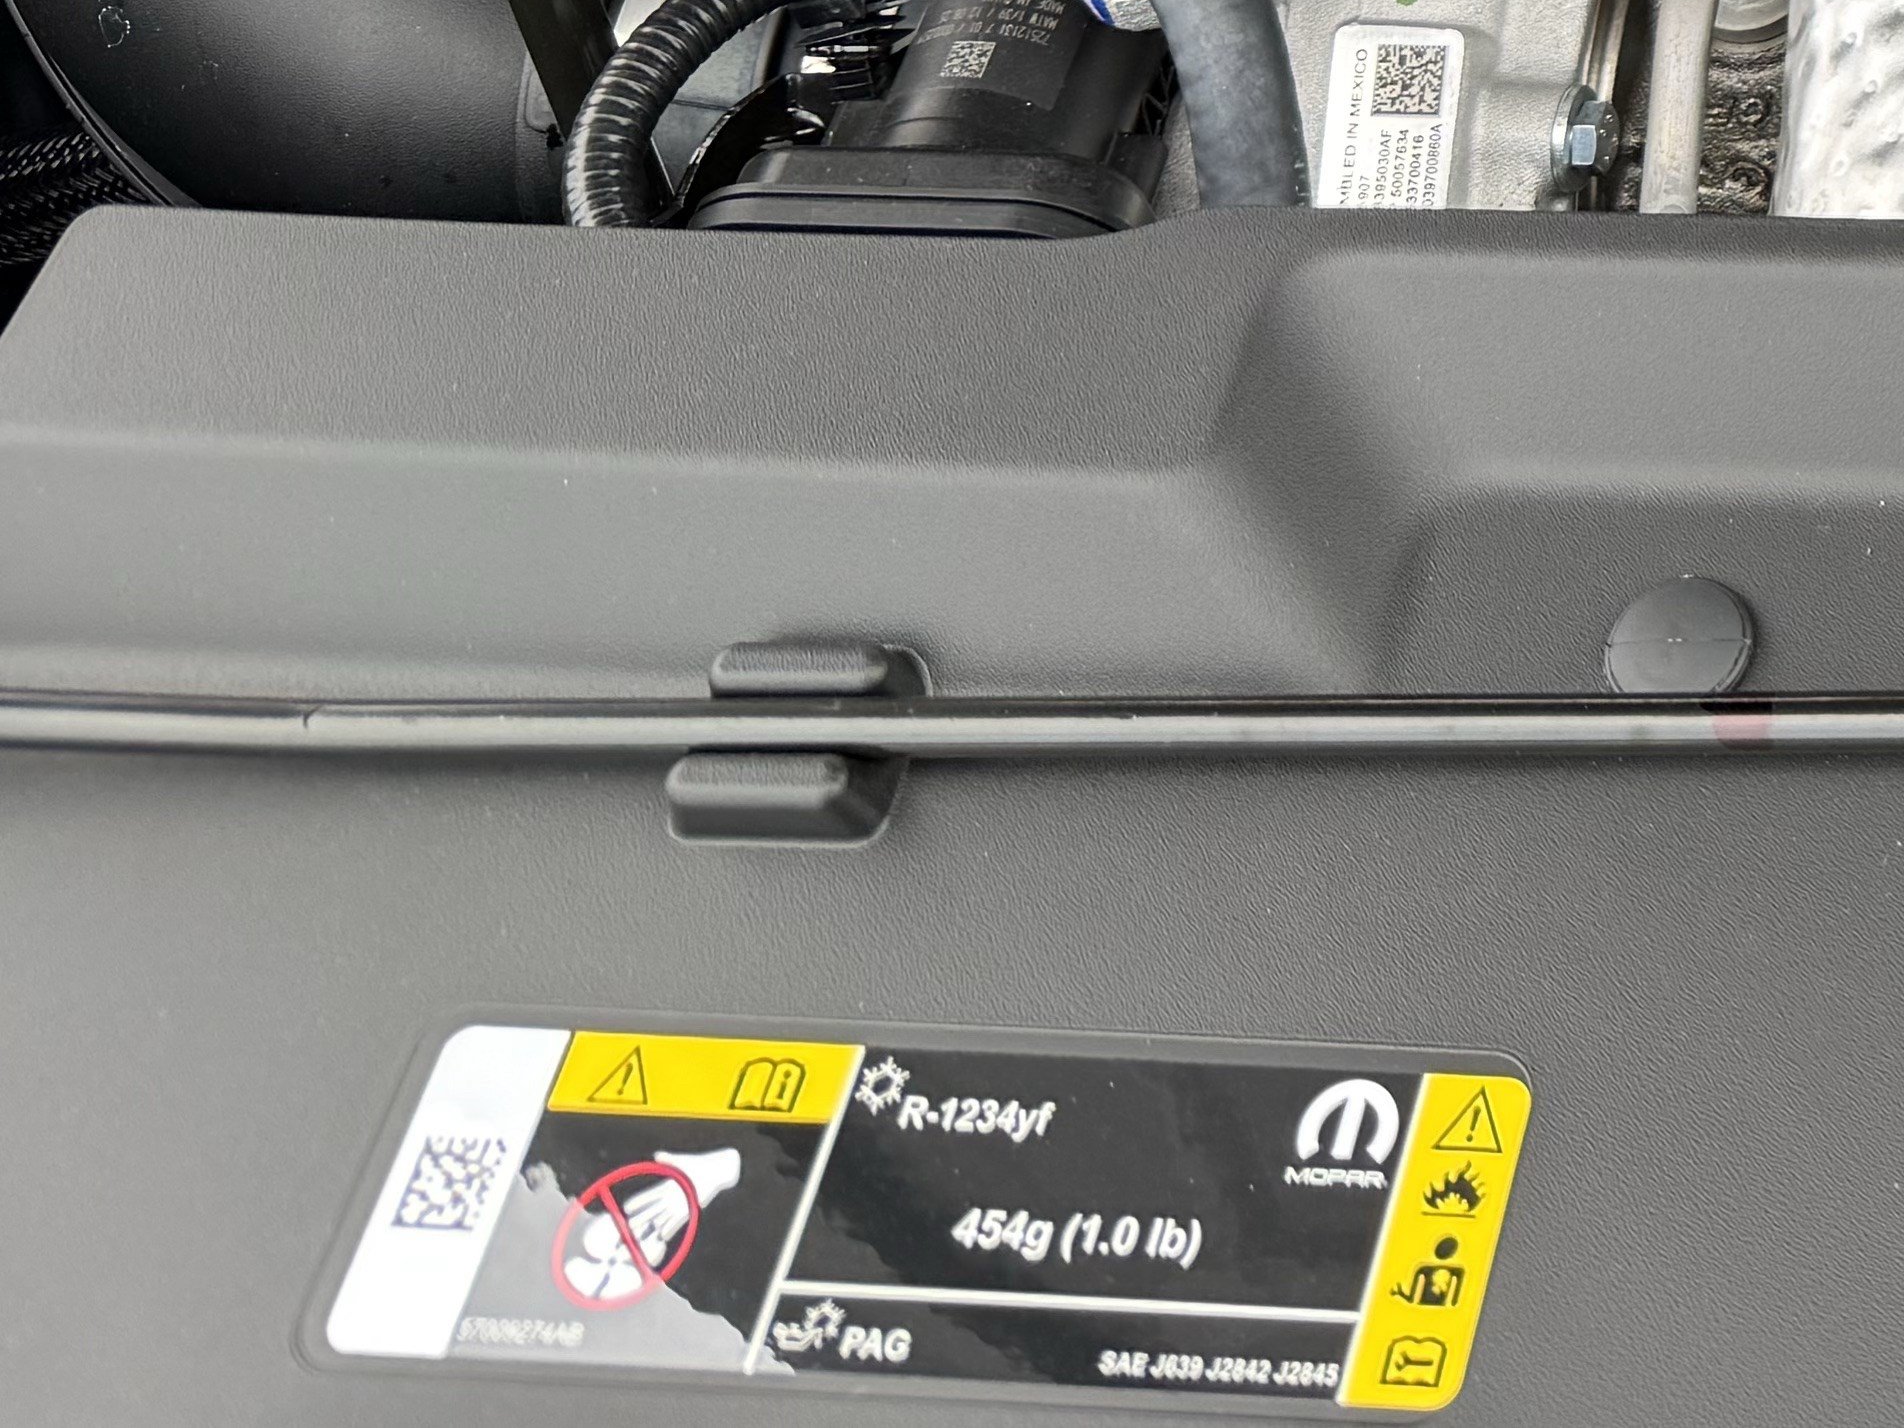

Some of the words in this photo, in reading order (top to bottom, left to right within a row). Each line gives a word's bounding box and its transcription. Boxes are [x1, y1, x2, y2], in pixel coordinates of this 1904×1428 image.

[1349, 47, 1369, 117] MEXICO
[1346, 123, 1359, 140] IN
[899, 1095, 1057, 1143] R-1234yf
[1284, 1166, 1389, 1190] MOPAR
[951, 1207, 1054, 1263] 454g
[1060, 1211, 1141, 1267] (1.0
[1145, 1216, 1204, 1268] lb)
[838, 1325, 913, 1363] PAG
[1097, 1348, 1150, 1379] SAE
[1151, 1350, 1204, 1382] J639
[1206, 1353, 1272, 1385] J2842
[1273, 1357, 1341, 1389] J2845
